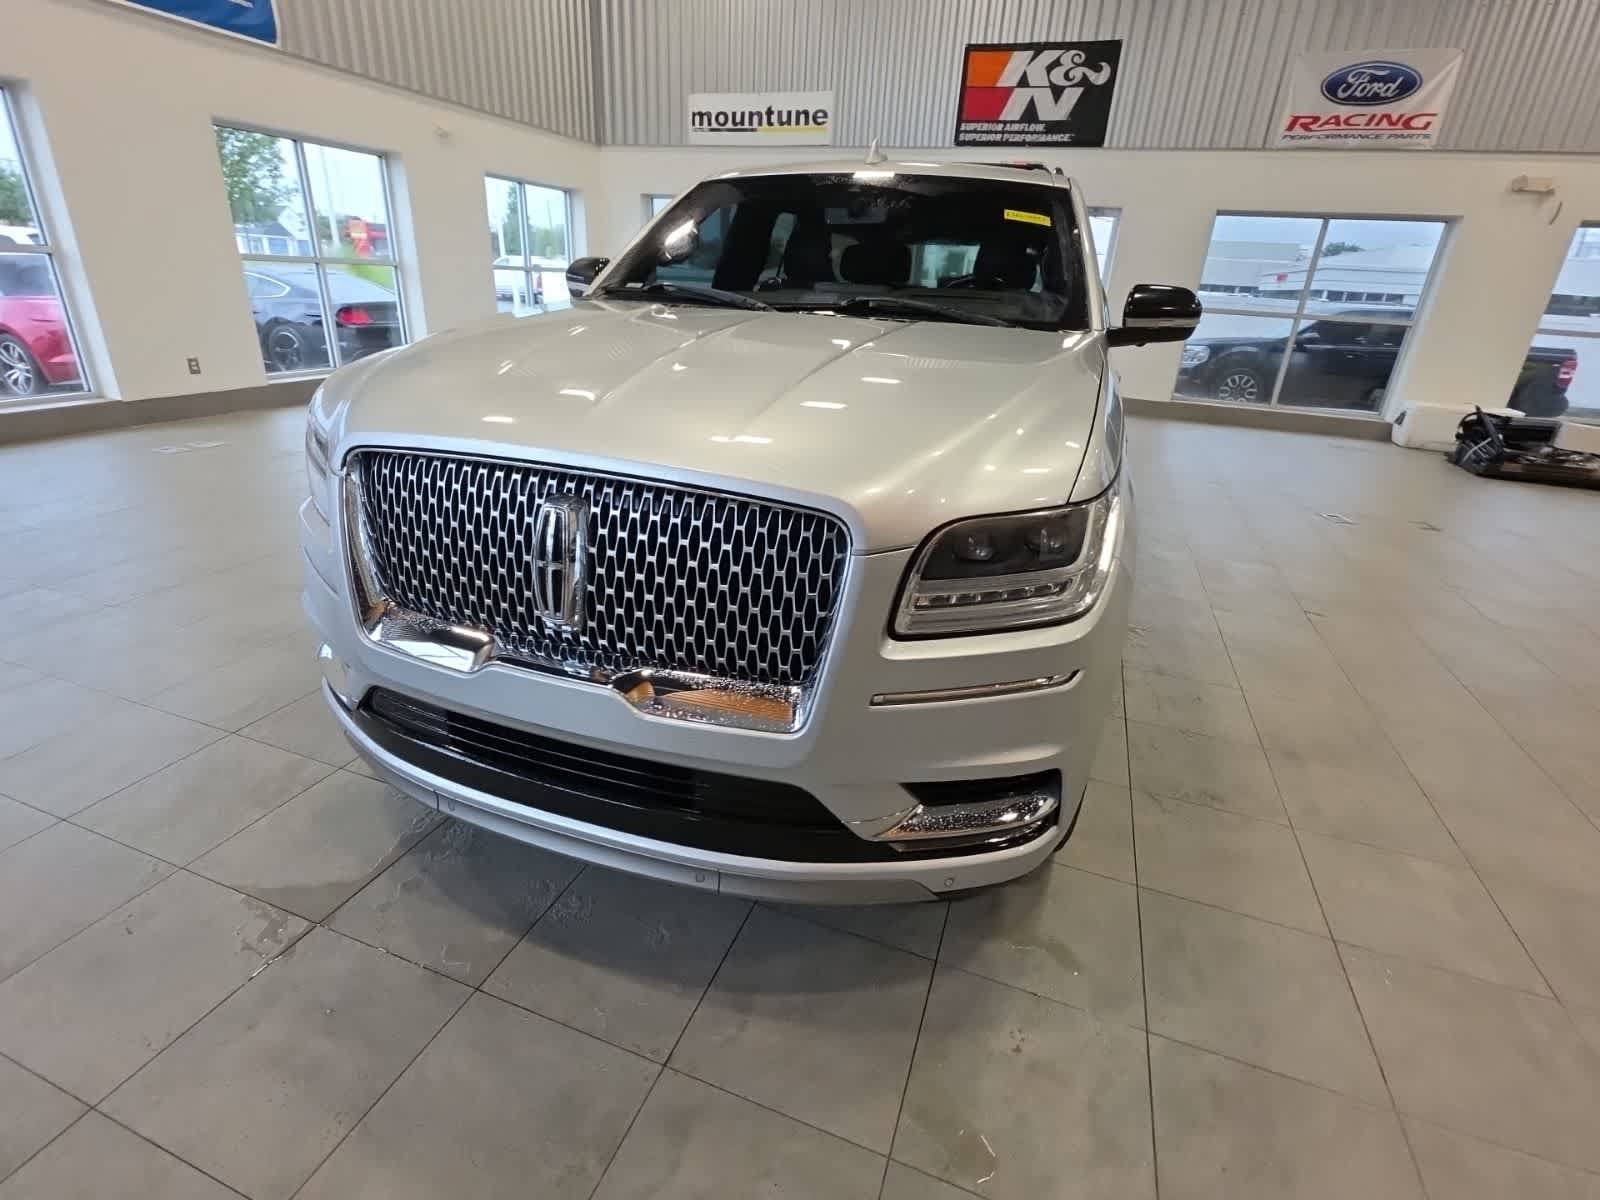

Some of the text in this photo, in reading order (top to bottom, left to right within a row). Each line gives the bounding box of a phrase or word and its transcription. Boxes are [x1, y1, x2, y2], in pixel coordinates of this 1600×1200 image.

[1337, 68, 1404, 98] Ford
[691, 105, 829, 127] mountune
[1284, 113, 1439, 132] RACING
[960, 122, 1004, 131] SUPERIOR
[959, 133, 1003, 141] SUPERIOR
